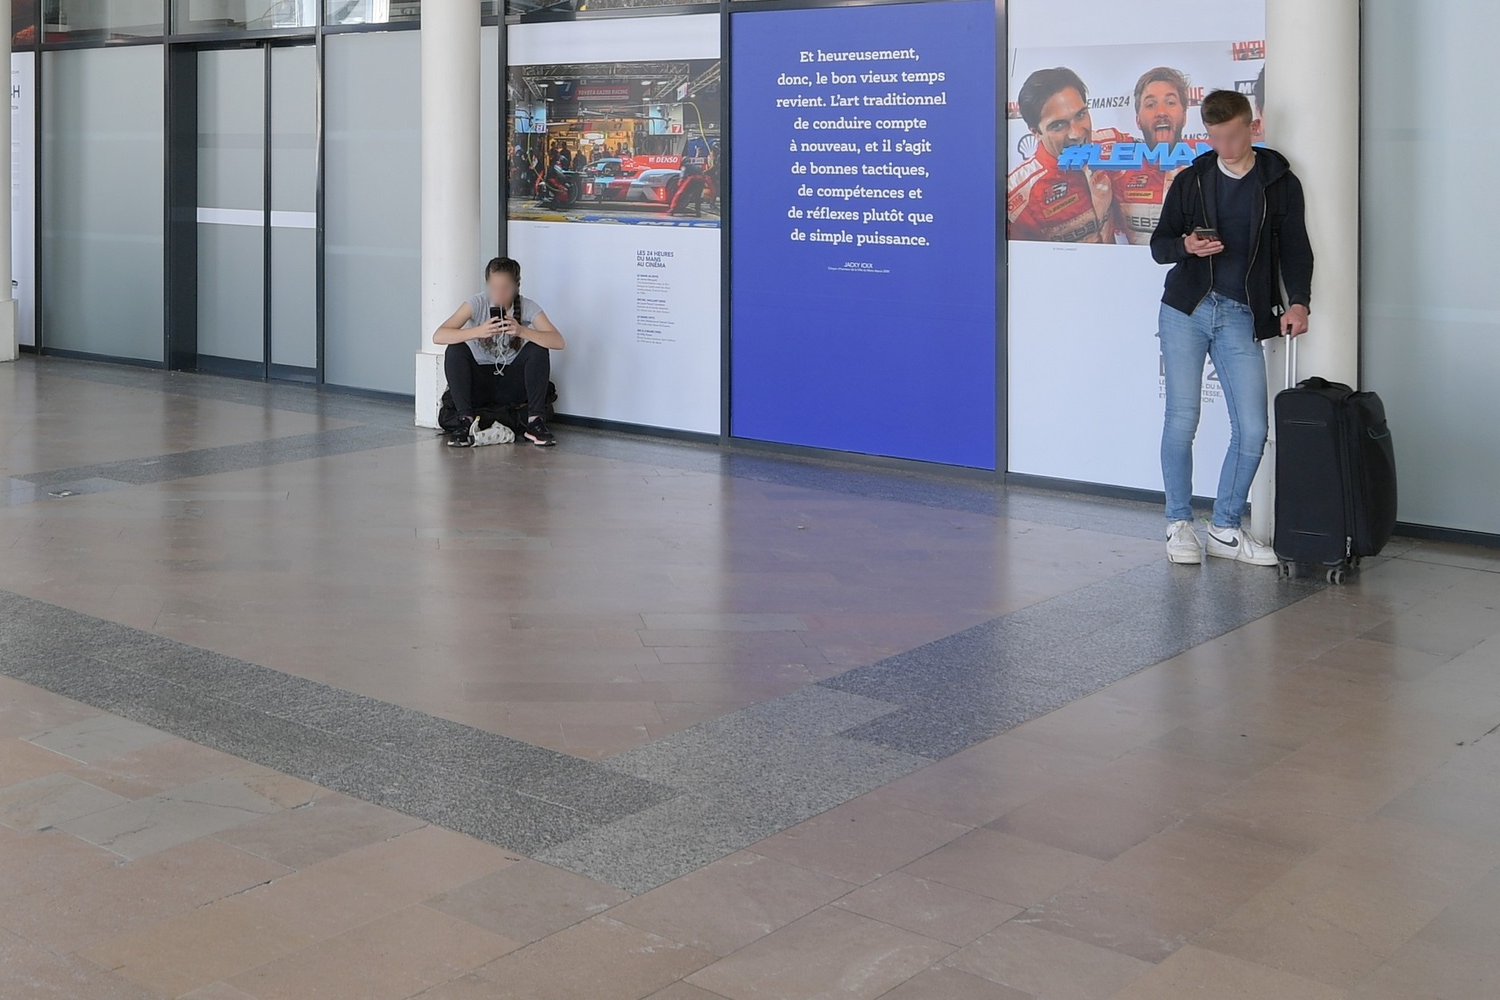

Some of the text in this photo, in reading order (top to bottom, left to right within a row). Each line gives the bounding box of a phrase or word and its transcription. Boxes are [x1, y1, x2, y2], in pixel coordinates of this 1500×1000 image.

[800, 48, 920, 62] Et heureusement,
[1232, 40, 1265, 62] MYTH
[778, 70, 946, 86] donc, le bon vieux temps
[776, 95, 826, 108] revient.
[863, 92, 946, 106] traditionnel
[1086, 96, 1130, 110] EMANS24
[794, 116, 926, 132] de conduire compte
[790, 139, 798, 152] à
[801, 142, 860, 154] nouveau,
[865, 141, 878, 152] et
[882, 139, 891, 152] il
[791, 162, 930, 178] de bonnes tactiques,
[586, 184, 593, 194] 7
[798, 184, 922, 200] de compétences et
[788, 206, 934, 225] de réflexes plutôt que
[790, 229, 930, 246] de simple puissance.
[1202, 390, 1222, 398] TESSE,
